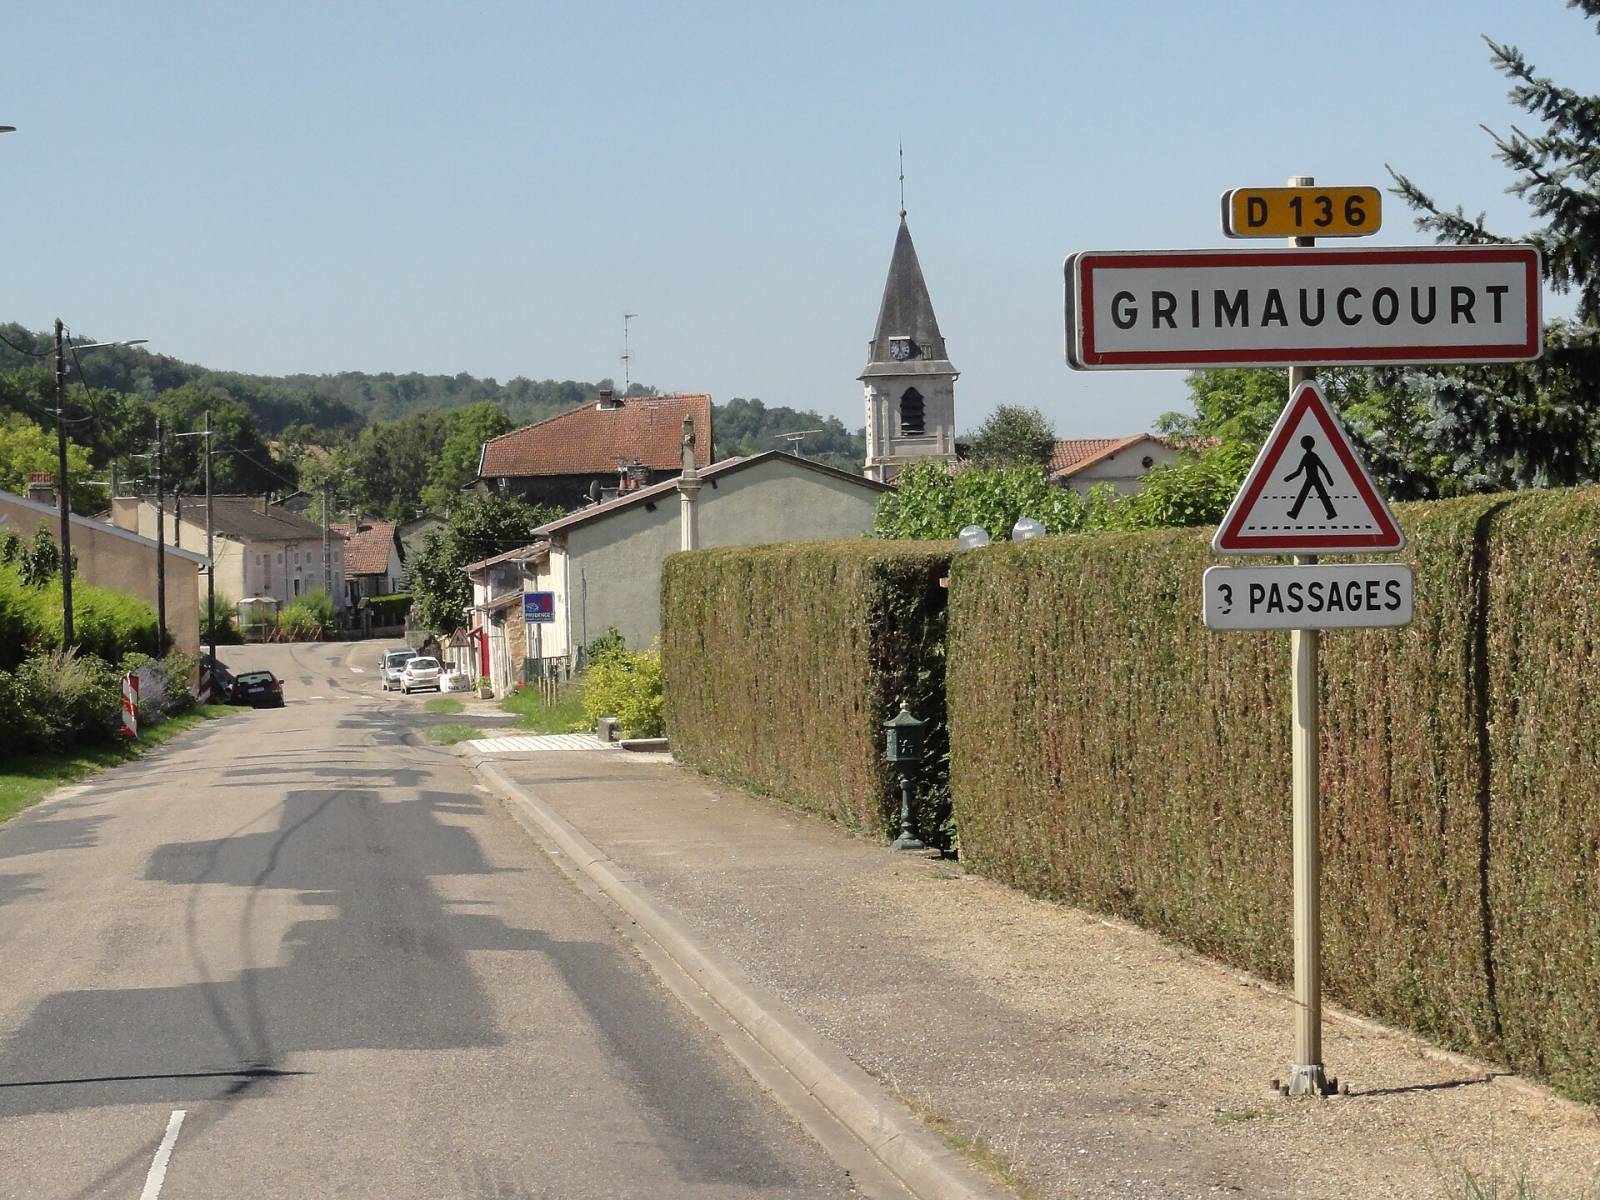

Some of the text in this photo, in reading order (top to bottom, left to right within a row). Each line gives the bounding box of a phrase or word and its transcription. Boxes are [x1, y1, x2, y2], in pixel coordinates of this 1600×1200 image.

[1247, 195, 1366, 228] D 136
[1110, 285, 1509, 330] GRIMAUCOURT
[1216, 579, 1401, 615] 3 PASSAGES
